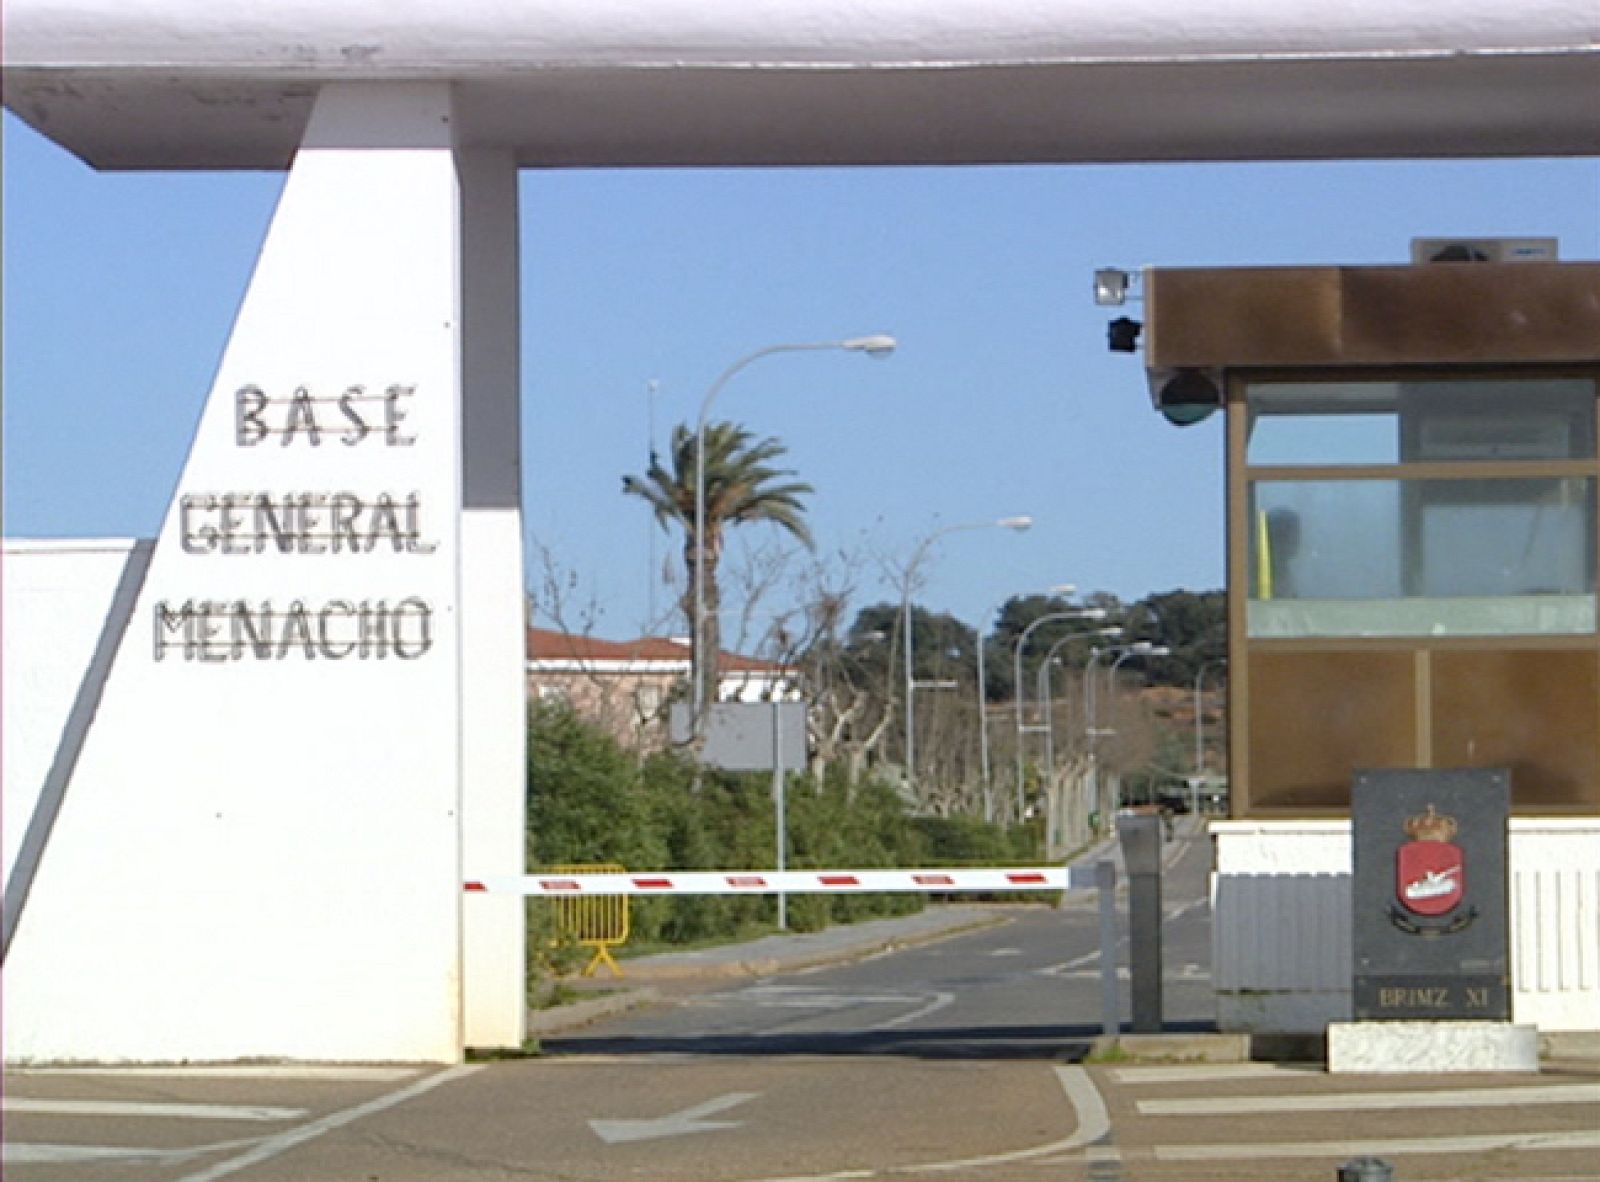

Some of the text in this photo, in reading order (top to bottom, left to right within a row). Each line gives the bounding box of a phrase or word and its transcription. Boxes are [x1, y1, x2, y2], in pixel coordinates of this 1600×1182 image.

[235, 384, 417, 446] BASE
[180, 491, 439, 554] GENERAL
[153, 597, 432, 662] MENACHO
[1379, 986, 1488, 1008] BRIMZ XI
